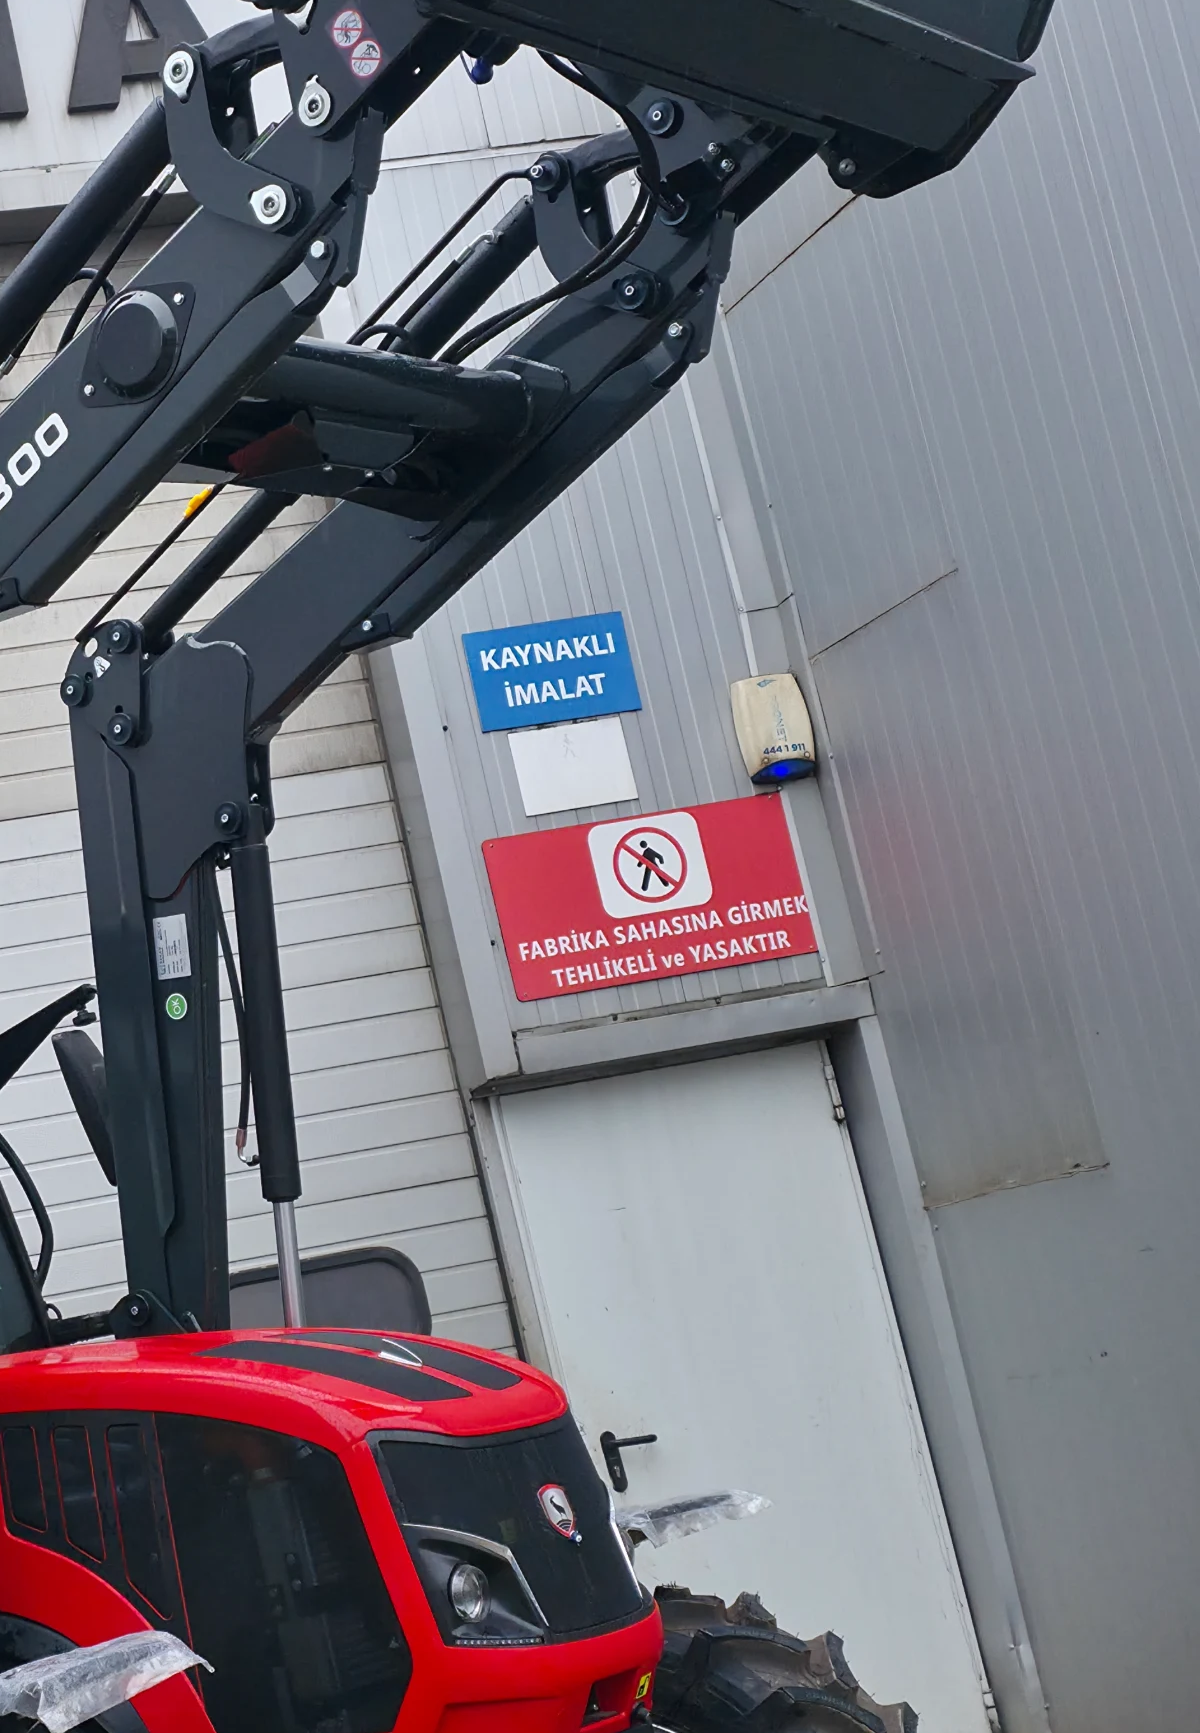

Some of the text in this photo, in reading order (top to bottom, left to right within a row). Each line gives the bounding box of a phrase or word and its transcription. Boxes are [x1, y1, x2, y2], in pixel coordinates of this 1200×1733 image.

[480, 632, 615, 671] KAYNAKLI
[504, 673, 605, 707] İMALAT
[763, 745, 783, 755] 444
[791, 743, 805, 752] 911
[519, 895, 809, 961] FABRİKA SAHASINA GİRMEK
[551, 930, 791, 987] TEHLİKELİ ve YASAKTIR
